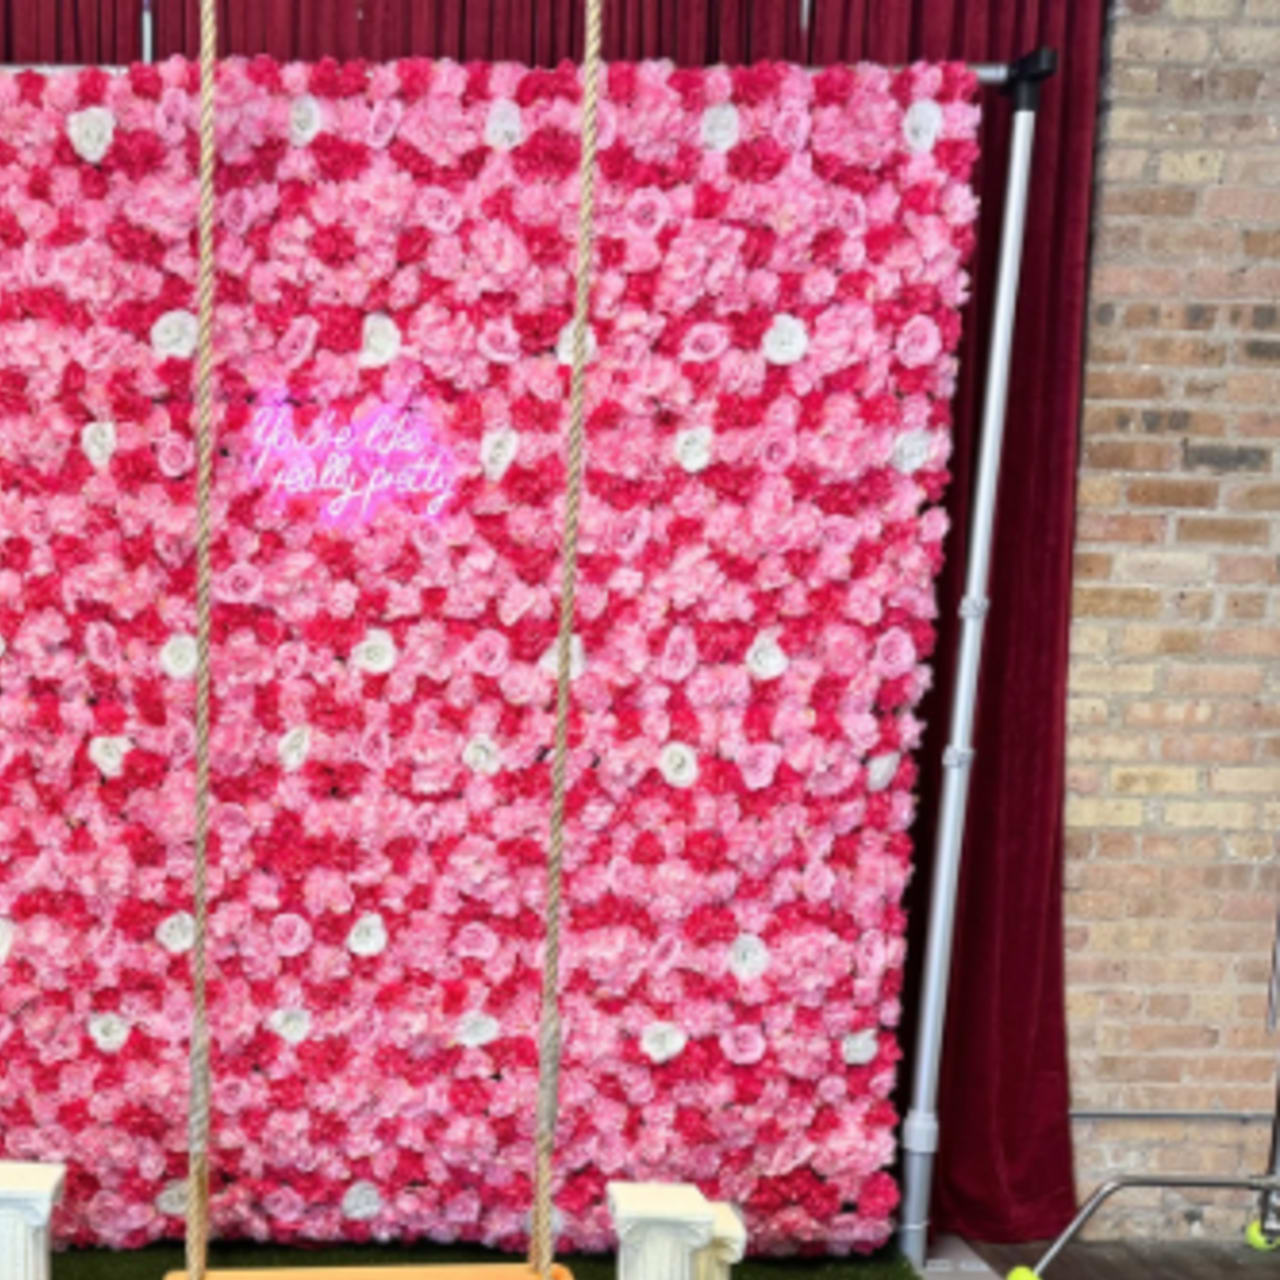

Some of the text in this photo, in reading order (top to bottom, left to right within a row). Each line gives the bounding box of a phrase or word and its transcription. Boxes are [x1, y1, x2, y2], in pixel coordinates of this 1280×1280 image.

[366, 412, 425, 454] like
[272, 451, 454, 516] really pretty
